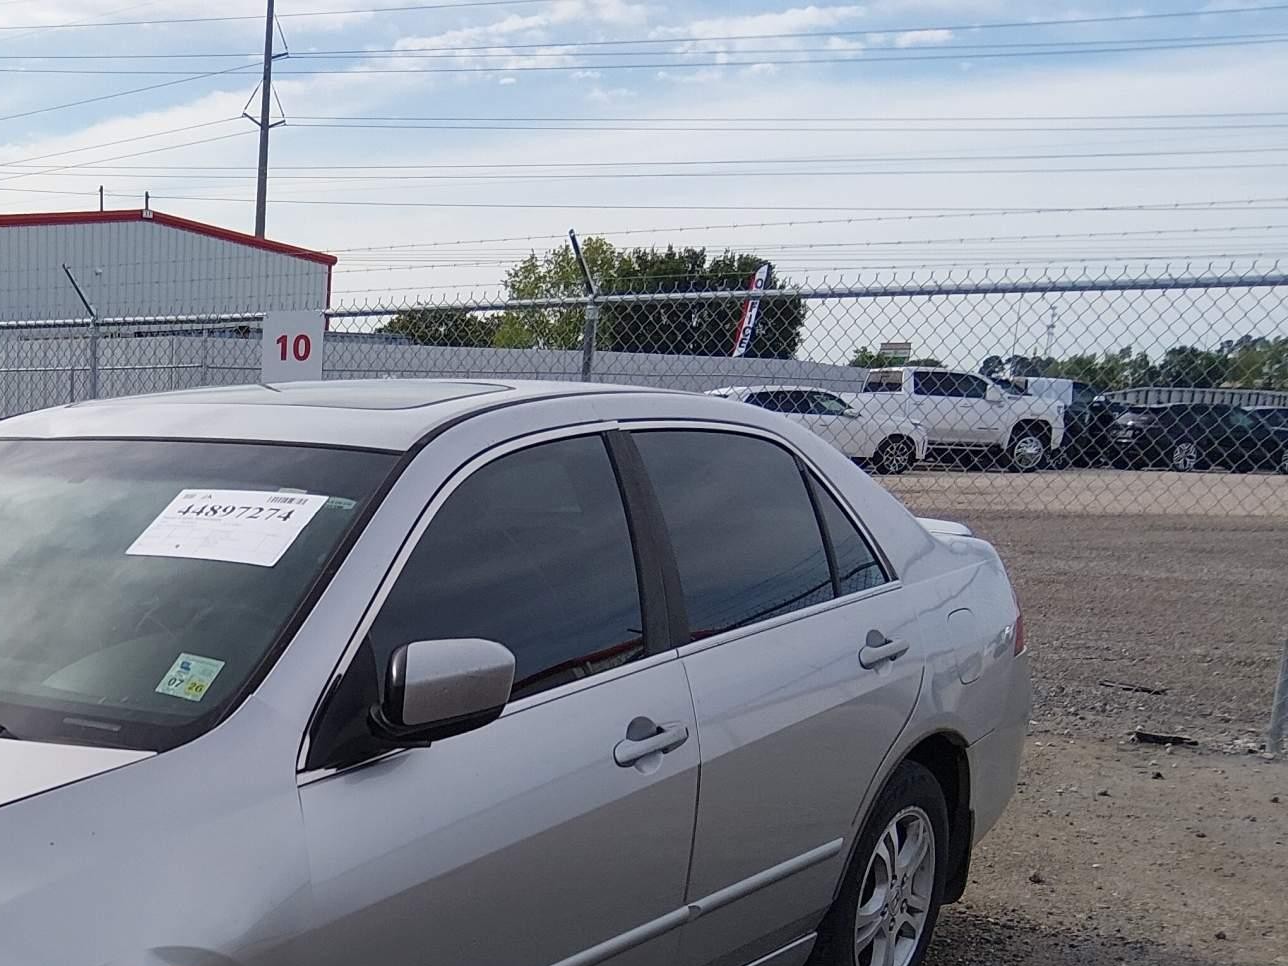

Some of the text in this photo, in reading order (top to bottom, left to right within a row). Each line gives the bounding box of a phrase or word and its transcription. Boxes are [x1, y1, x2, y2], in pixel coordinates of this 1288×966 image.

[738, 278, 764, 349] OFICE
[275, 334, 312, 362] 10
[177, 503, 296, 522] 44897274
[167, 676, 185, 688] 07
